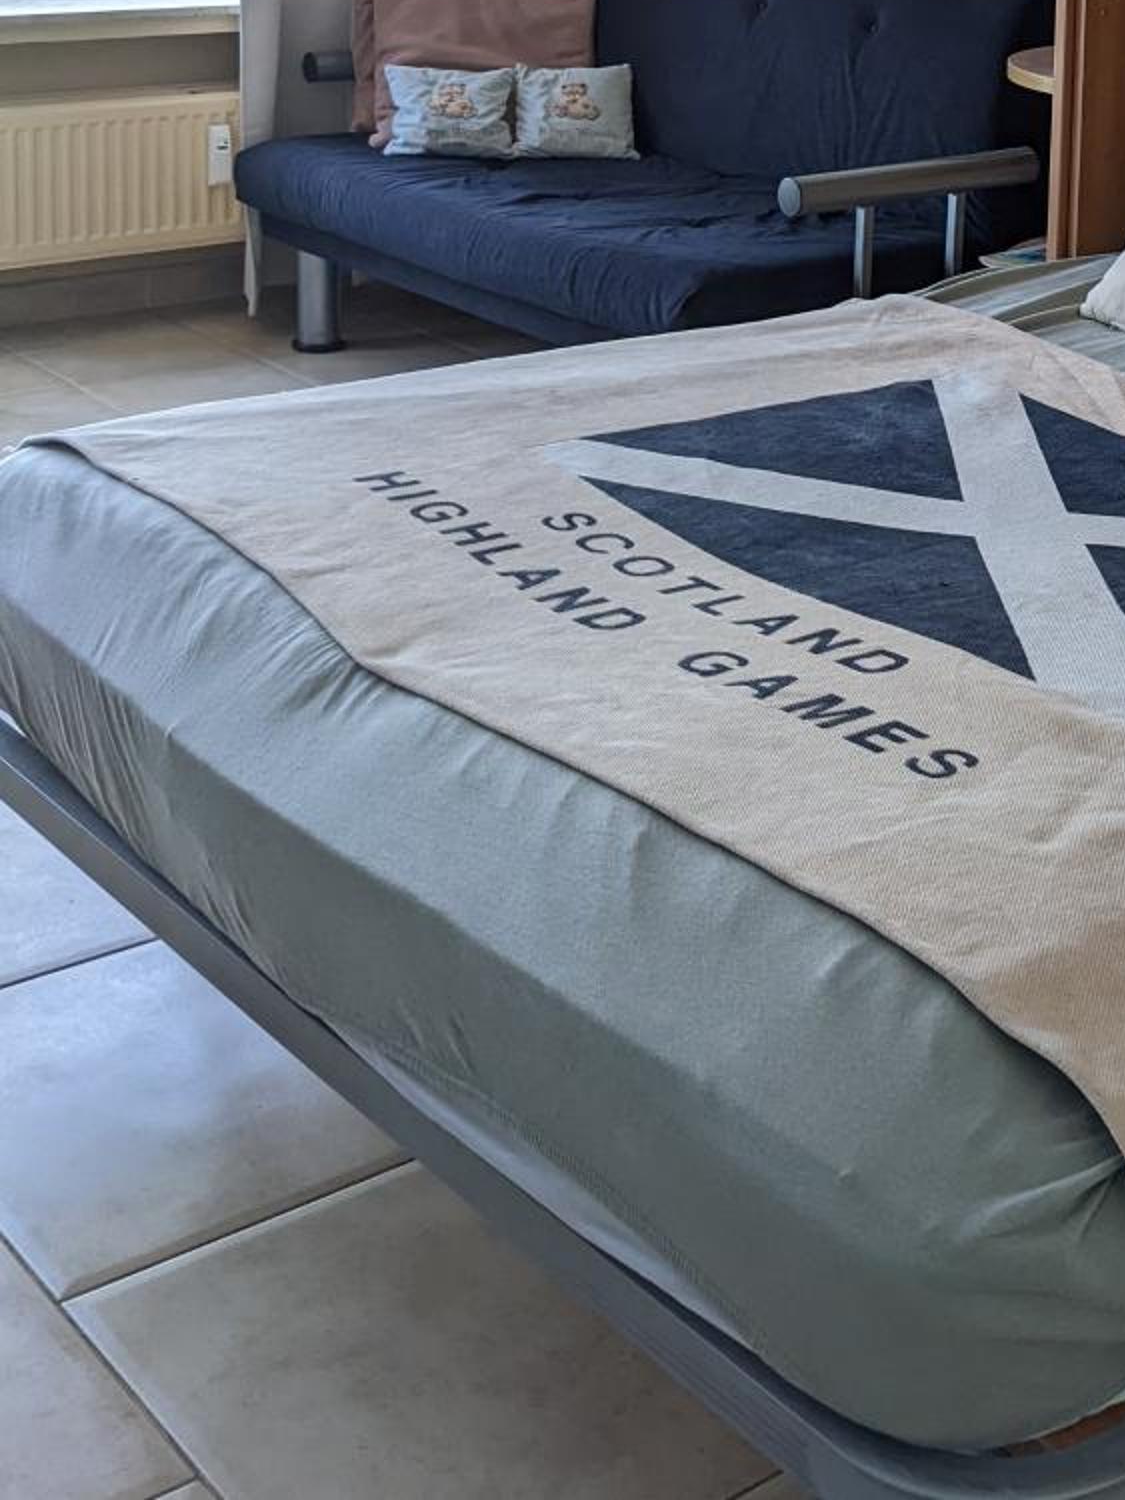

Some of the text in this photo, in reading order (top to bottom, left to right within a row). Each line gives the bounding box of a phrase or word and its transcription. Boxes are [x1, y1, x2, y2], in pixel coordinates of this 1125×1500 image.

[354, 470, 980, 780] HIGHLAND GAMES
[541, 511, 909, 674] SCOTLAND
